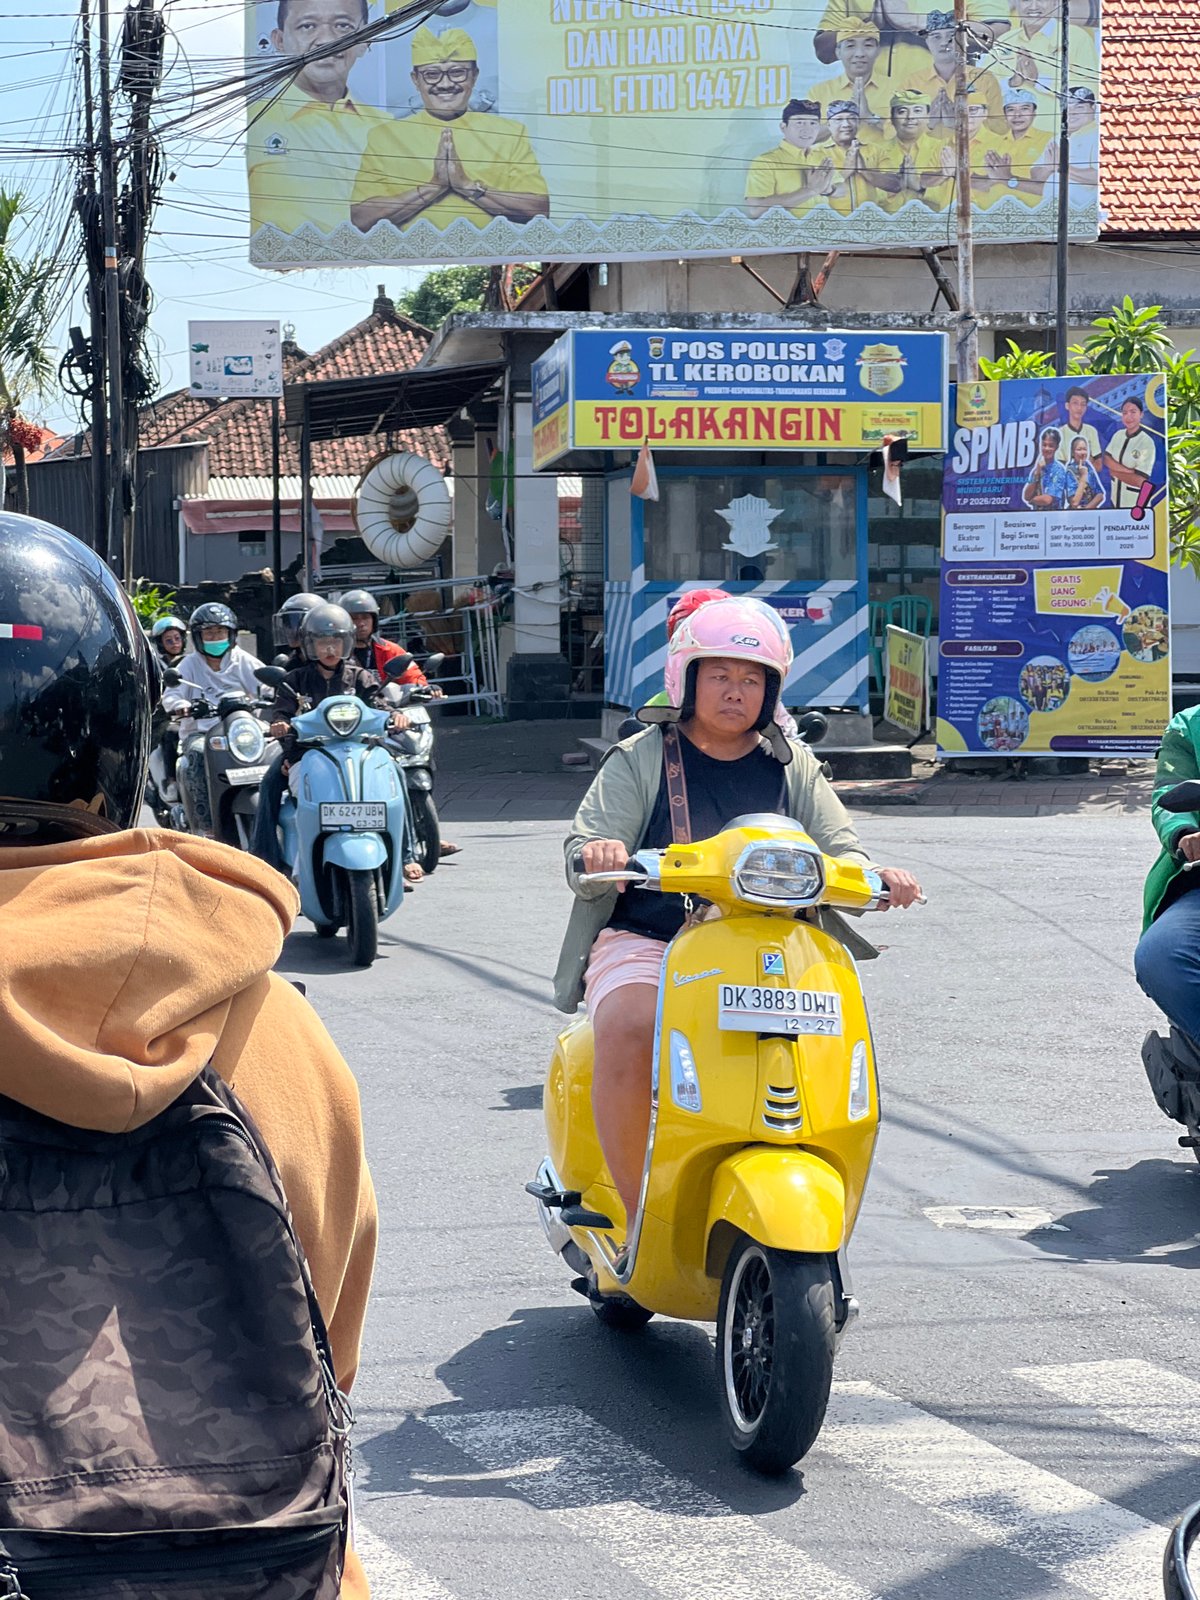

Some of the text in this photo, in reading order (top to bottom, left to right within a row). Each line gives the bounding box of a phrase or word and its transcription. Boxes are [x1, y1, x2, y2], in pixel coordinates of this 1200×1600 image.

[566, 23, 758, 68] DAN HARI RAYA
[549, 77, 604, 114] IDUL
[613, 72, 676, 112] FITRI
[685, 69, 747, 109] 1447
[671, 341, 816, 361] POS POLISI
[648, 363, 845, 383] TL KEROBOKAN
[952, 420, 1037, 474] SPMB
[957, 478, 985, 486] SISTEM
[982, 486, 1003, 494] BARU
[956, 497, 1011, 506] T.P 2026/2027
[953, 523, 985, 531] Beragam
[1001, 531, 1039, 541] Bagi Siswa
[1000, 543, 1040, 552] Berprestasi
[1050, 575, 1082, 584] GRATIS
[1050, 587, 1076, 596] UANG
[1050, 599, 1087, 607] GEDUNG
[776, 608, 805, 617] KER
[323, 806, 336, 816] DK
[338, 806, 363, 816] 6247
[723, 986, 837, 1014] DK 3883 DWI
[784, 1018, 799, 1030] 12
[817, 1020, 836, 1031] 27
